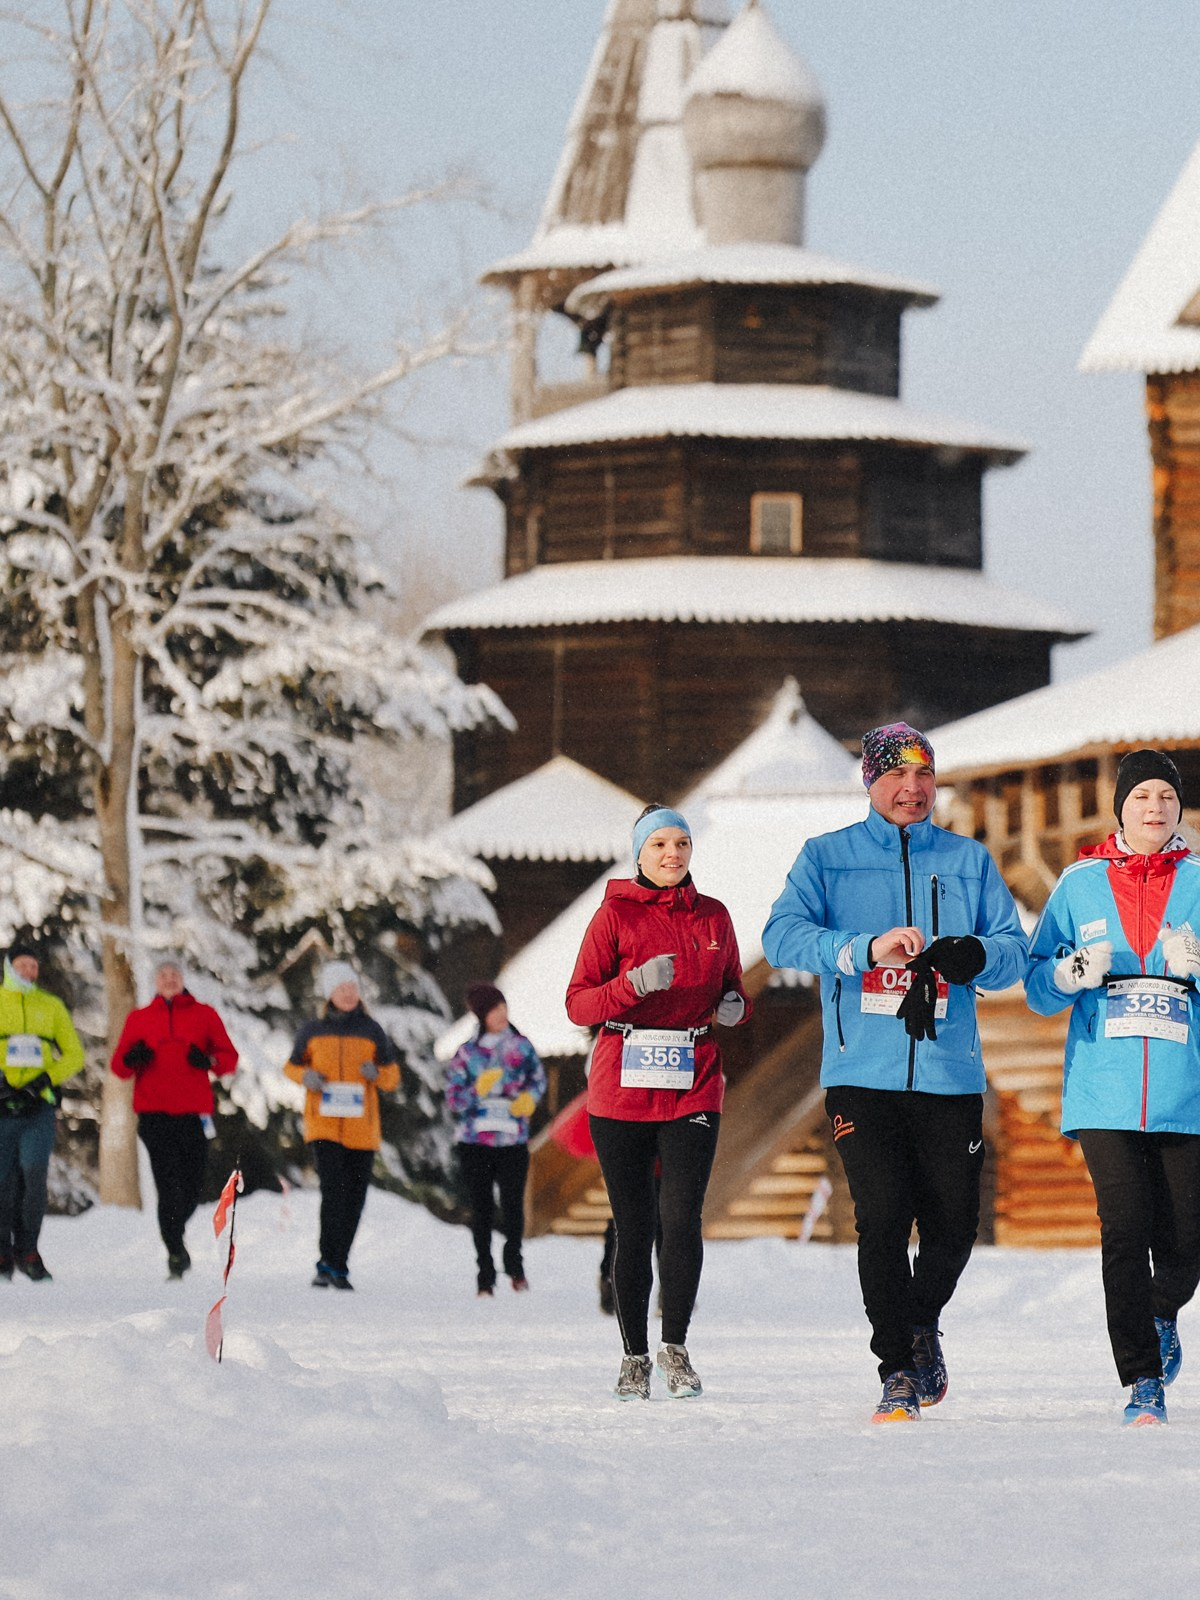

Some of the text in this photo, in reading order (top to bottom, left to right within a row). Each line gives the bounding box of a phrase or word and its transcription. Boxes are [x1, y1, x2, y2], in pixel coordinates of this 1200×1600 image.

[882, 969, 917, 990] 04
[1125, 994, 1170, 1014] 325
[640, 1047, 681, 1066] 356
